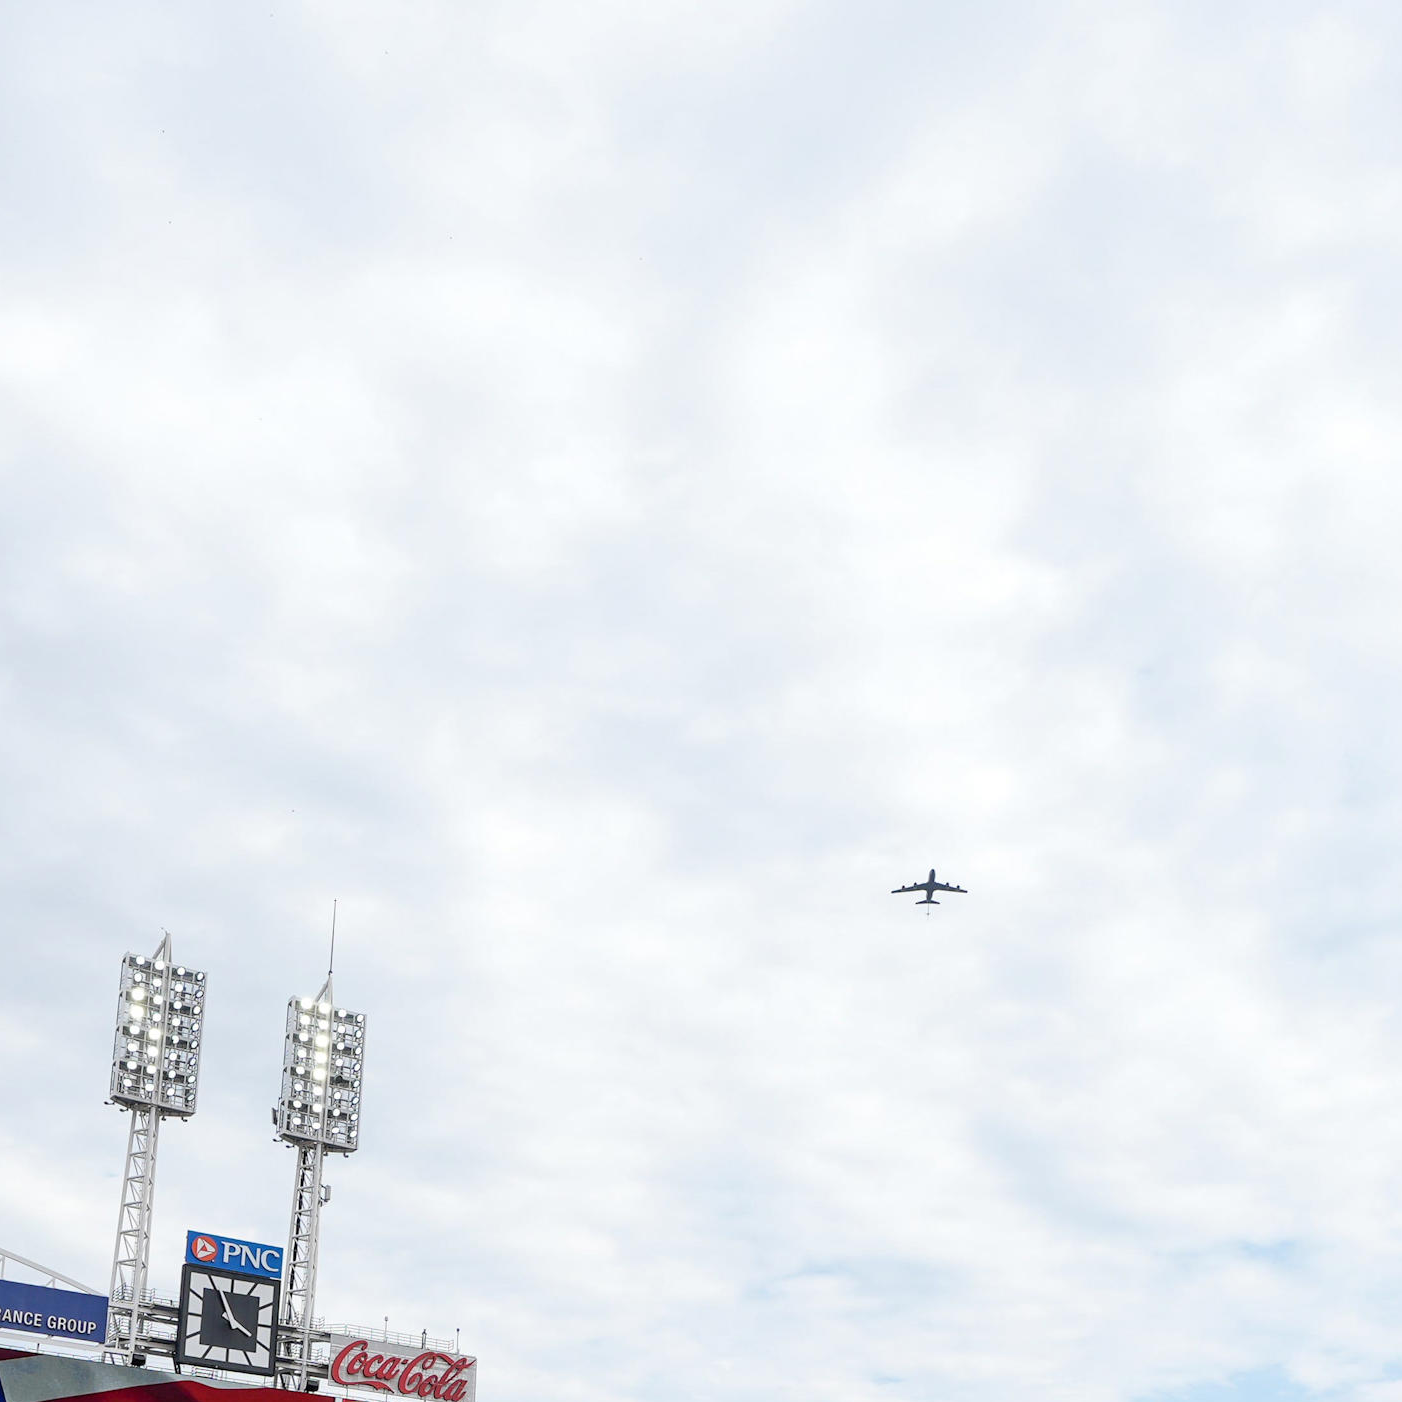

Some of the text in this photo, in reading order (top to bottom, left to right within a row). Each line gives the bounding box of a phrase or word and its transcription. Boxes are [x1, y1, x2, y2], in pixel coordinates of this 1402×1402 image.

[221, 1241, 281, 1273] PNC
[47, 1315, 97, 1336] GROUP
[329, 1340, 477, 1402] Coca-Cola
